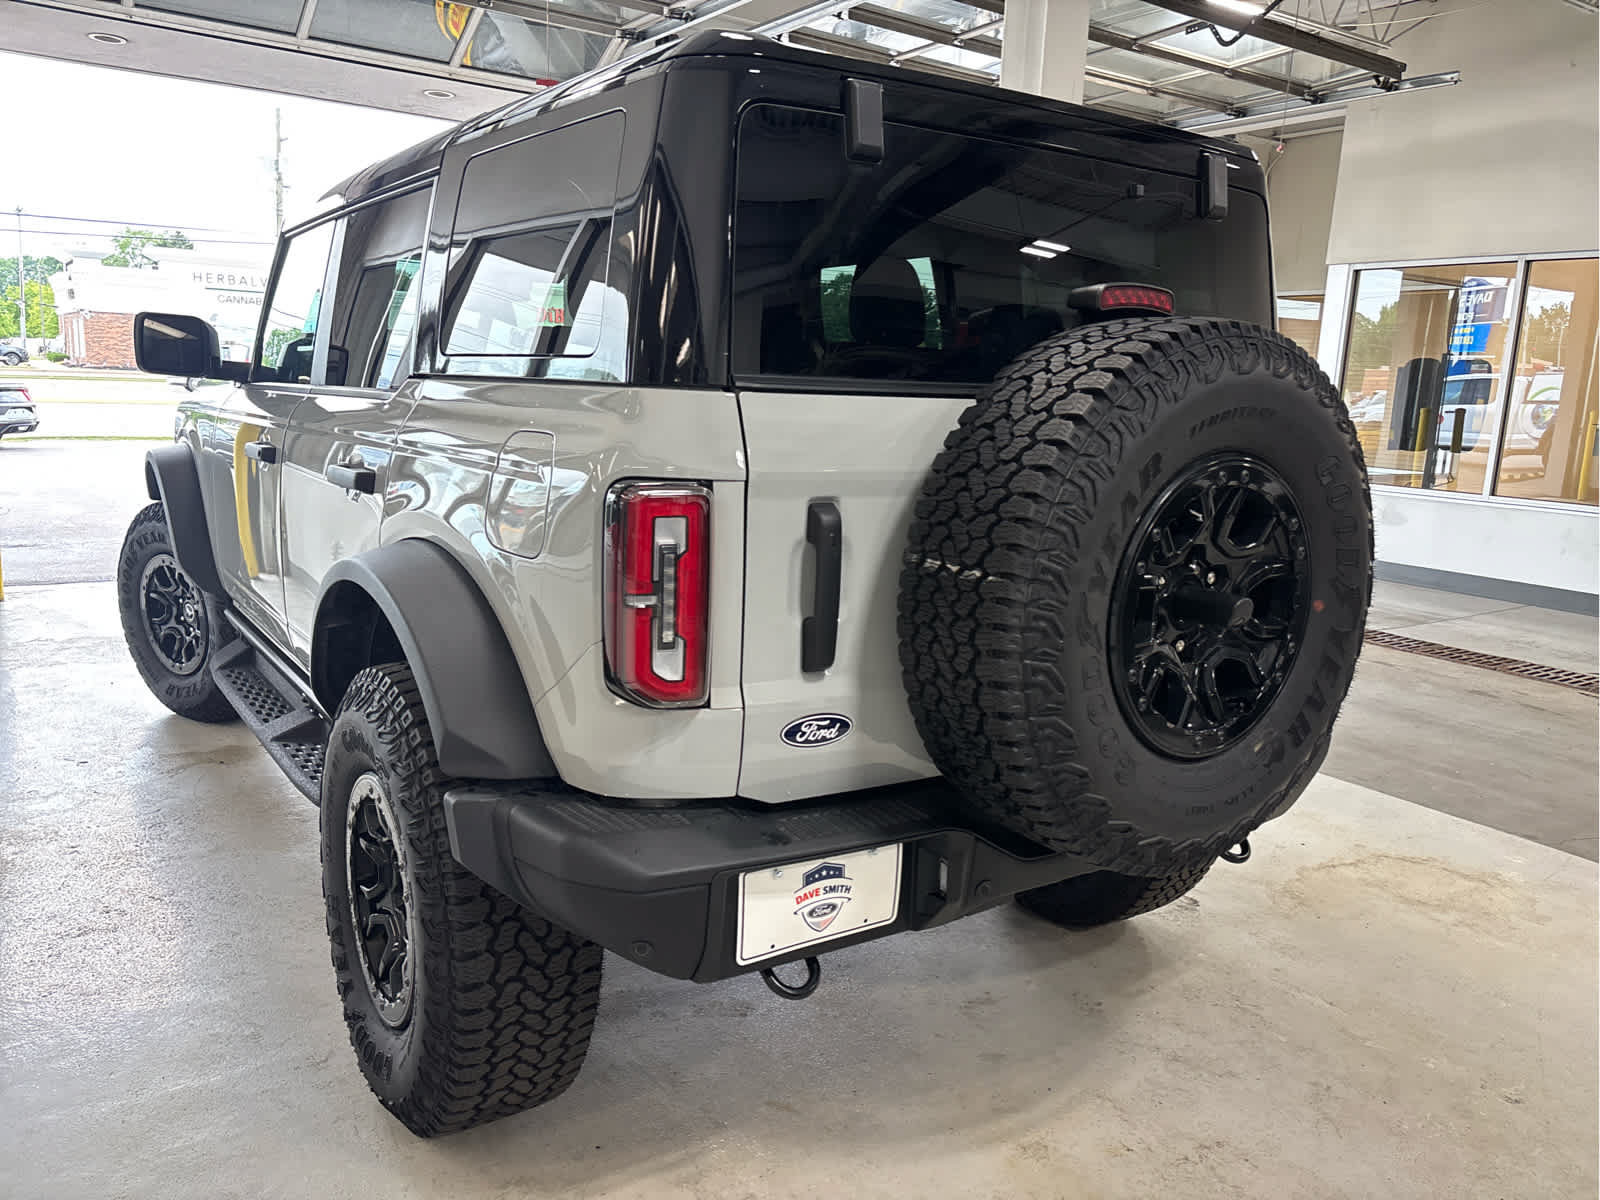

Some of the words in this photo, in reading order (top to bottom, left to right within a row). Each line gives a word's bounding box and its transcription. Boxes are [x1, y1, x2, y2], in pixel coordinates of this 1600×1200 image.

[1285, 455, 1363, 750] GOODYEAR
[796, 718, 841, 742] Ford
[795, 887, 820, 905] DAVE
[822, 884, 852, 896] SMITH
